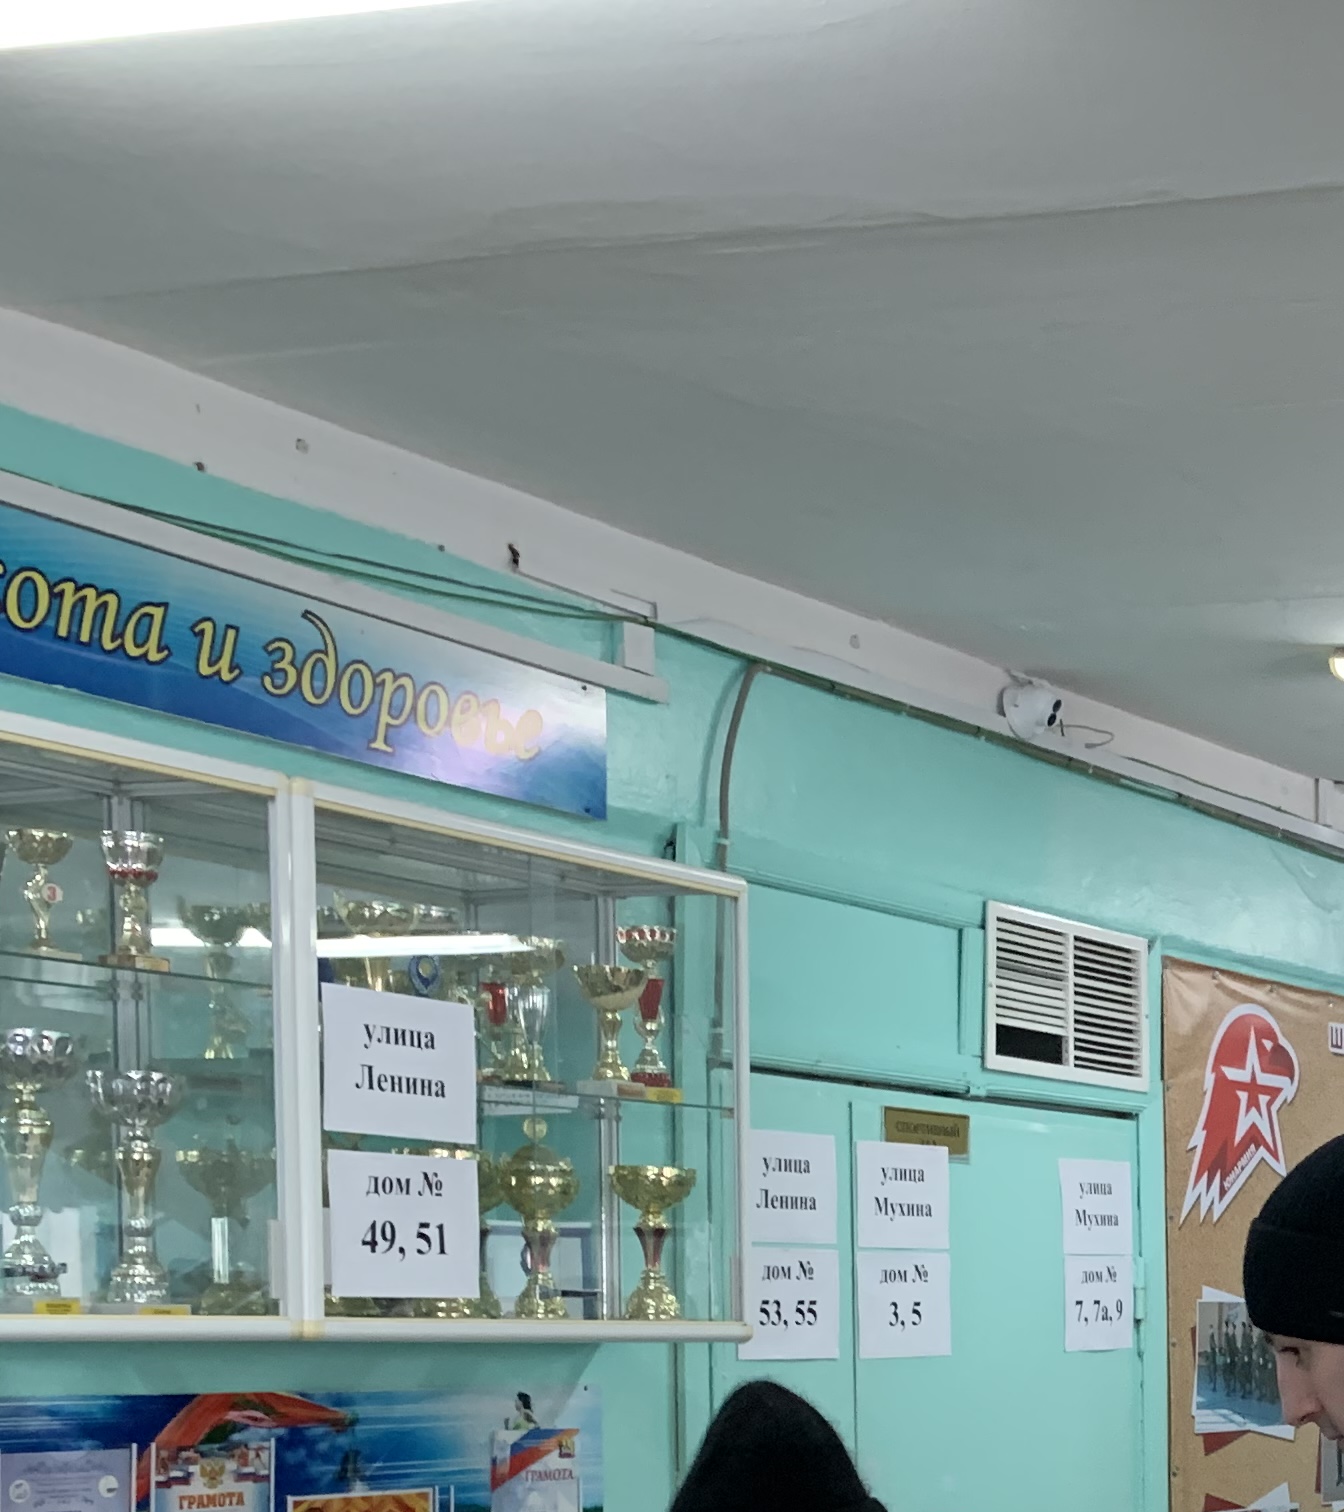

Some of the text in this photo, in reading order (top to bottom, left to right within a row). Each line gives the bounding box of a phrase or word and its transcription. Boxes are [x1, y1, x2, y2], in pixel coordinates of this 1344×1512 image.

[0, 560, 544, 759] ота и здоровье
[363, 1023, 437, 1051] улица
[355, 1063, 446, 1099] Ленина
[763, 1155, 811, 1176] улица
[880, 1165, 925, 1185] улица
[366, 1170, 444, 1198] дом №
[1078, 1180, 1113, 1198] улица
[756, 1189, 817, 1211] Ленина
[874, 1196, 933, 1221] Мухина
[1075, 1208, 1119, 1231] Мухина
[361, 1219, 448, 1261] 49, 51
[761, 1260, 814, 1282] дом №
[879, 1263, 929, 1285] дом №
[1081, 1265, 1117, 1286] дом №
[758, 1300, 818, 1329] 53, 55
[888, 1301, 923, 1330] 3, 5
[1075, 1300, 1090, 1326] 7,
[1116, 1299, 1123, 1321] 9
[524, 1468, 574, 1482] ГРАМОТА
[178, 1491, 245, 1511] ГРАМОТА
